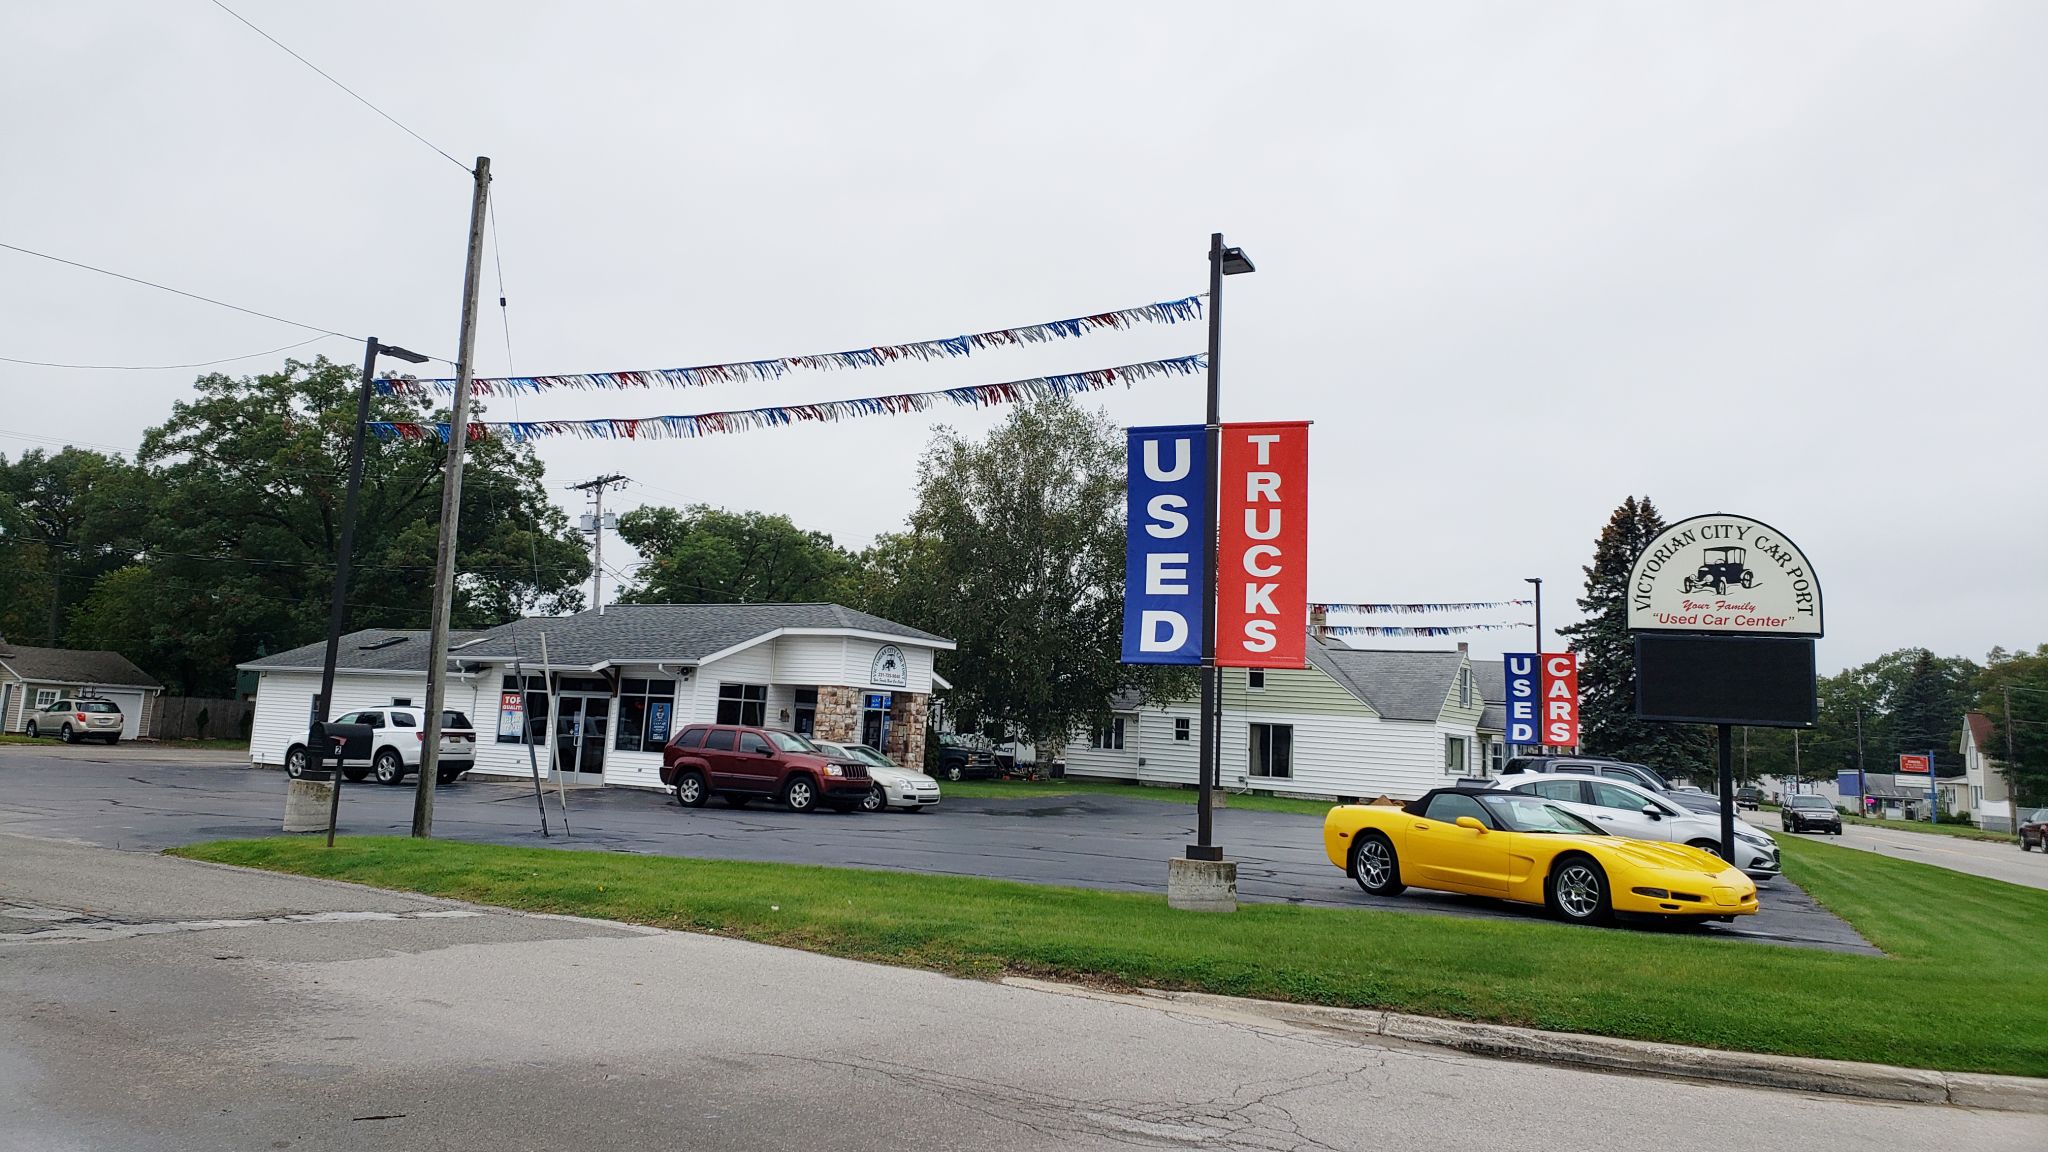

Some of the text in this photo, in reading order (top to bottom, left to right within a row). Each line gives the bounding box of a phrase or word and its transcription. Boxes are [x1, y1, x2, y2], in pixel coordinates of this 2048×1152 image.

[1140, 438, 1191, 652] USED
[1242, 434, 1283, 653] TRUCKS
[1632, 524, 1814, 617] VICTORIAN CITY CAR PORT
[1653, 612, 1795, 628] "Used Car Center"
[1681, 599, 1757, 613] Your Family
[1510, 657, 1533, 741] USED
[1547, 657, 1572, 742] CARS
